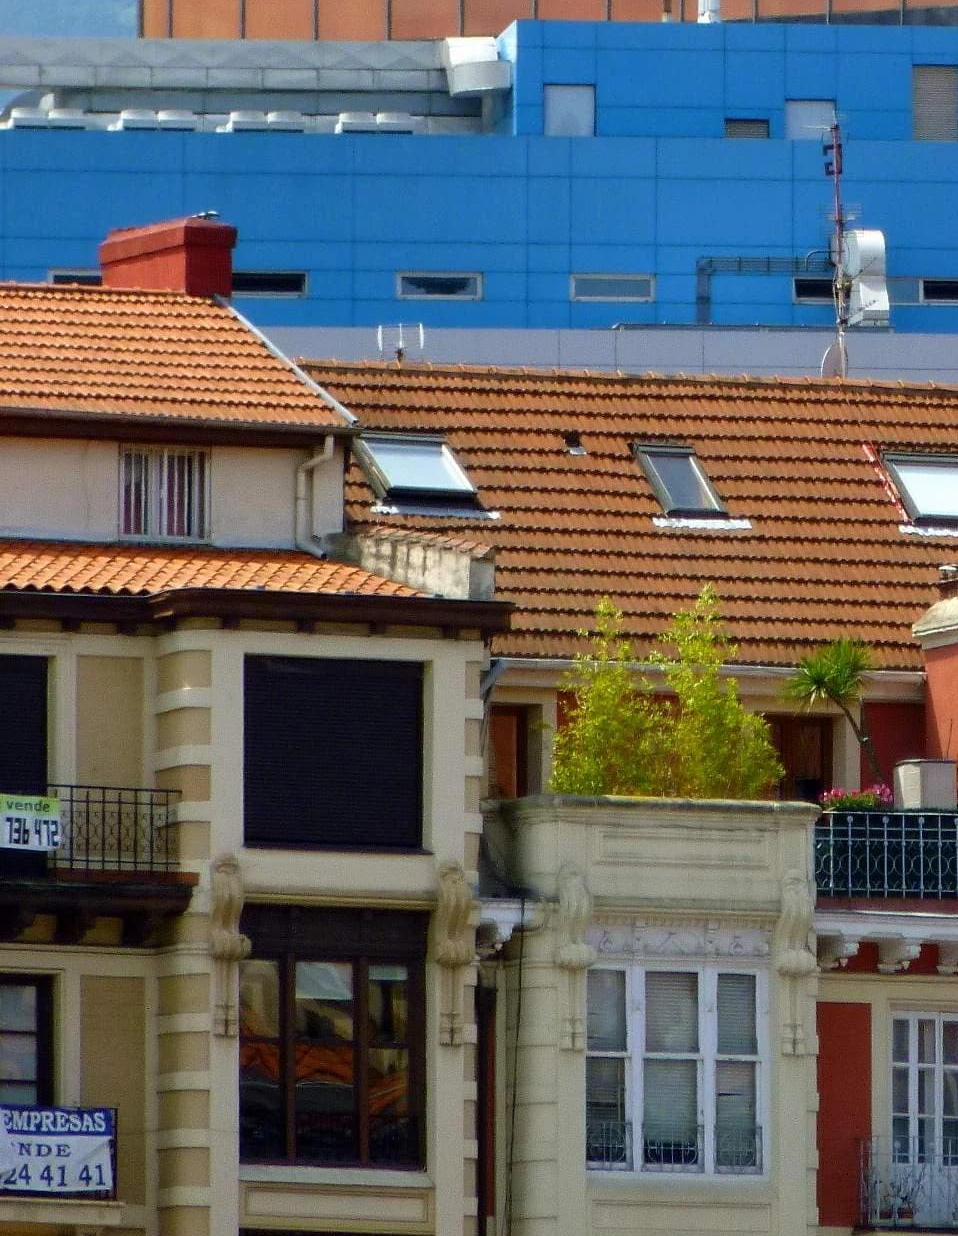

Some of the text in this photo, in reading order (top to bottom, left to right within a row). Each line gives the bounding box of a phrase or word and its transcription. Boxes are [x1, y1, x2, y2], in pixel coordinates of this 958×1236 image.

[34, 818, 60, 847] 472
[0, 1110, 106, 1133] EMPRESAS
[39, 1164, 68, 1187] 41
[78, 1164, 106, 1187] 41
